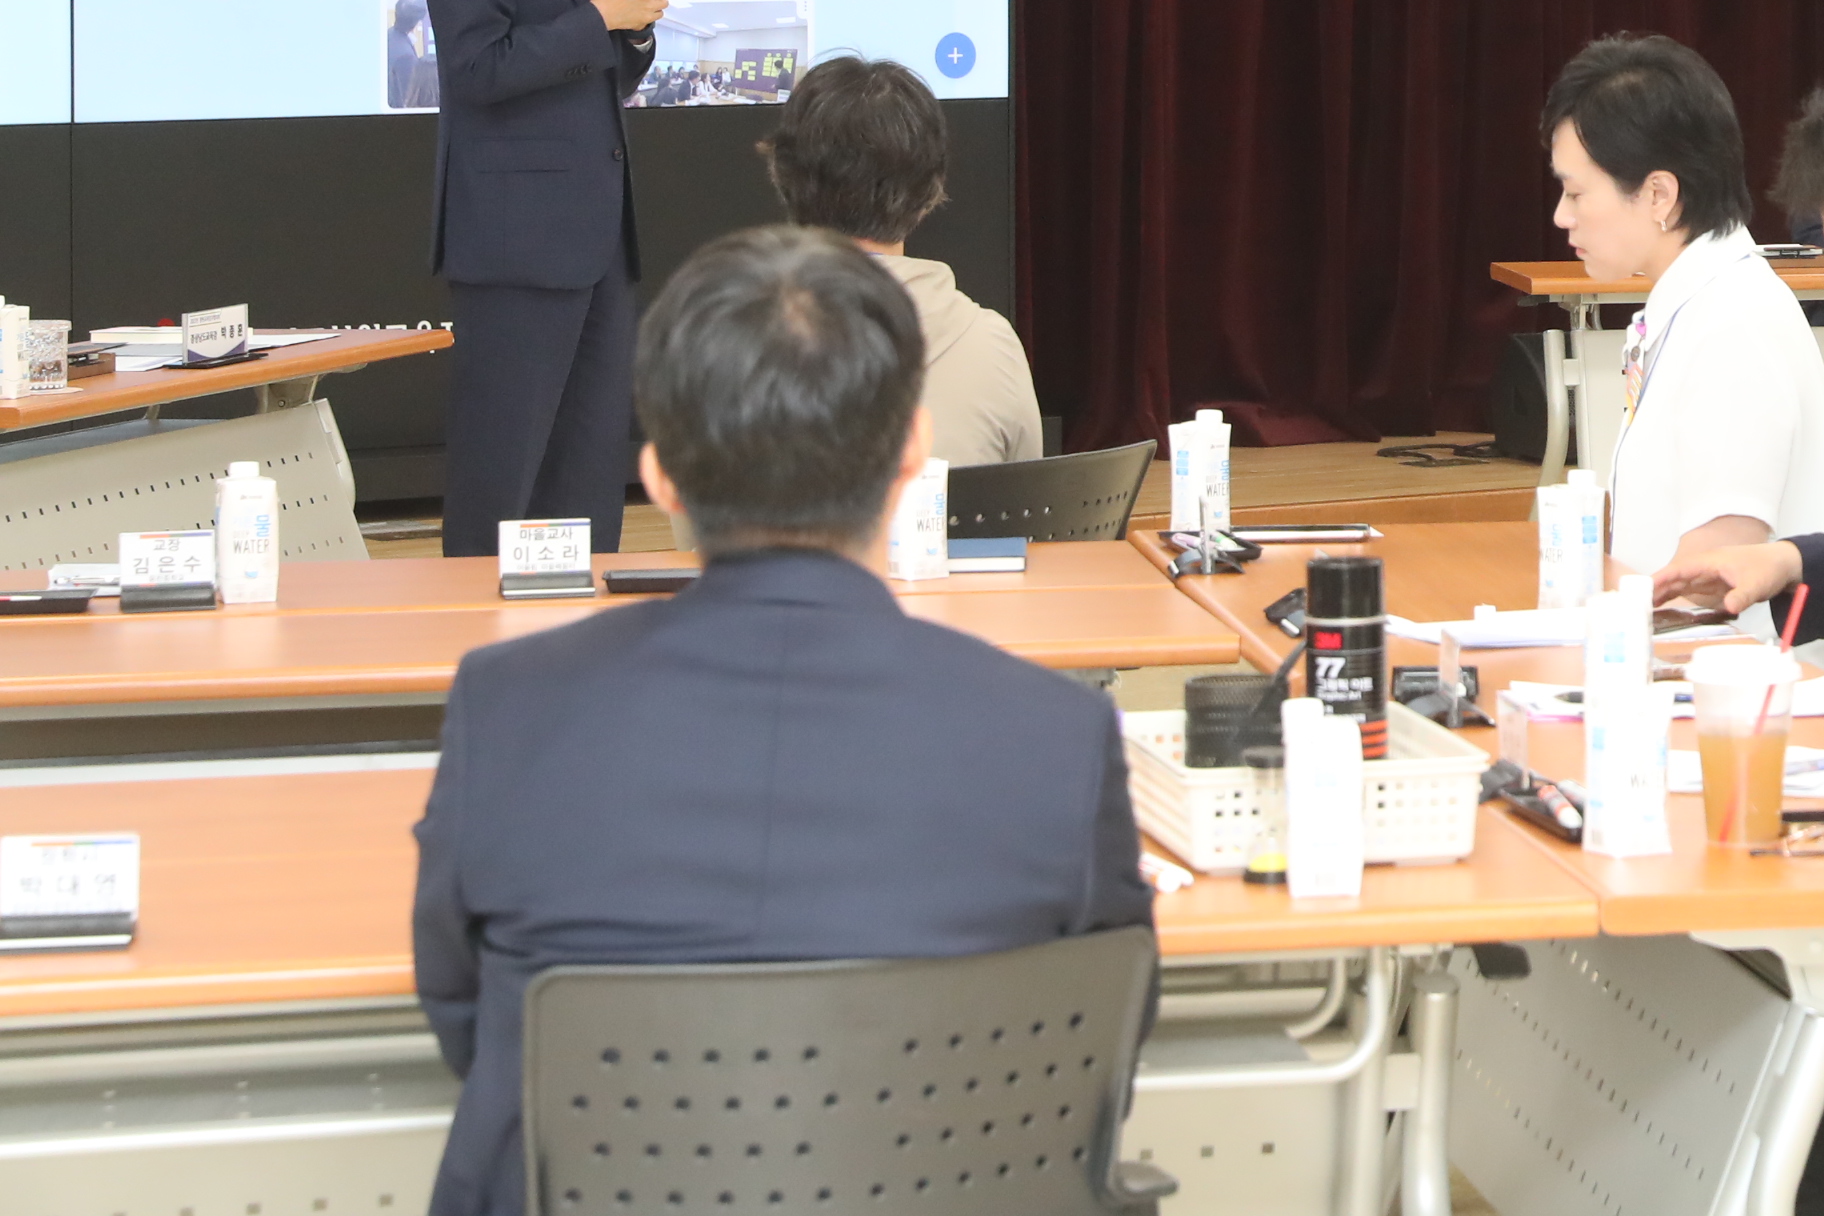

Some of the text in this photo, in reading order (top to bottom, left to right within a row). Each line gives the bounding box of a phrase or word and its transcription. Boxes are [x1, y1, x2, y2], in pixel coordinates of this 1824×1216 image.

[519, 527, 573, 541] 마을교사
[153, 539, 180, 552] 교장
[233, 539, 270, 554] WATER
[1315, 657, 1346, 679] 77
